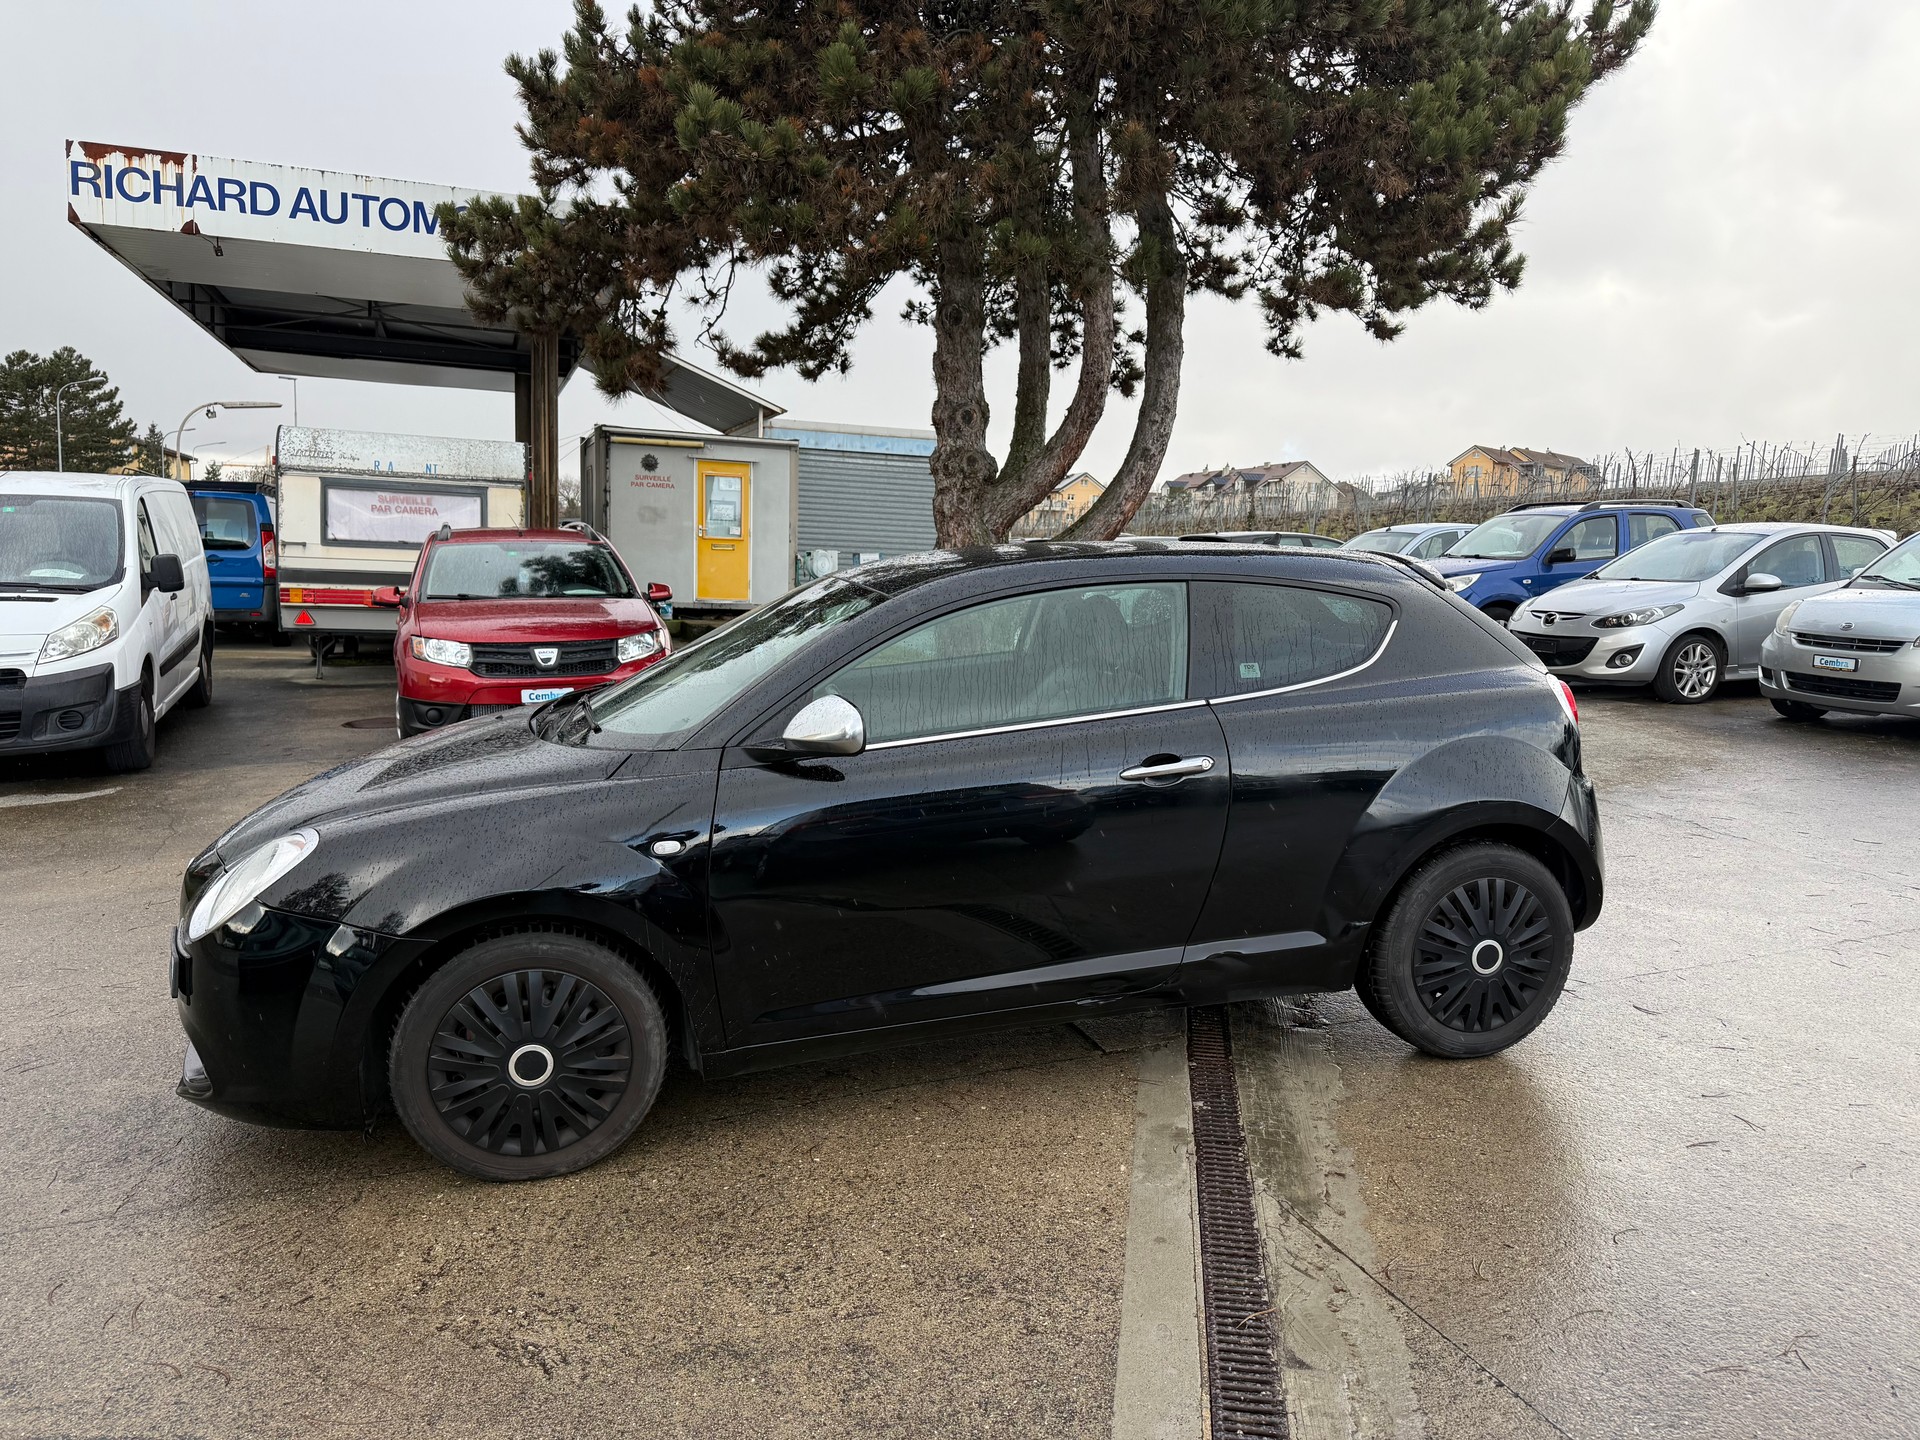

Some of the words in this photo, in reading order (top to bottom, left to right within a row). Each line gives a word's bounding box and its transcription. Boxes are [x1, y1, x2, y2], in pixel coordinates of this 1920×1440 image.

[70, 160, 281, 217] RICHARD
[370, 504, 391, 514] PAR
[394, 505, 439, 516] CAMERA
[1819, 657, 1849, 668] Cembra
